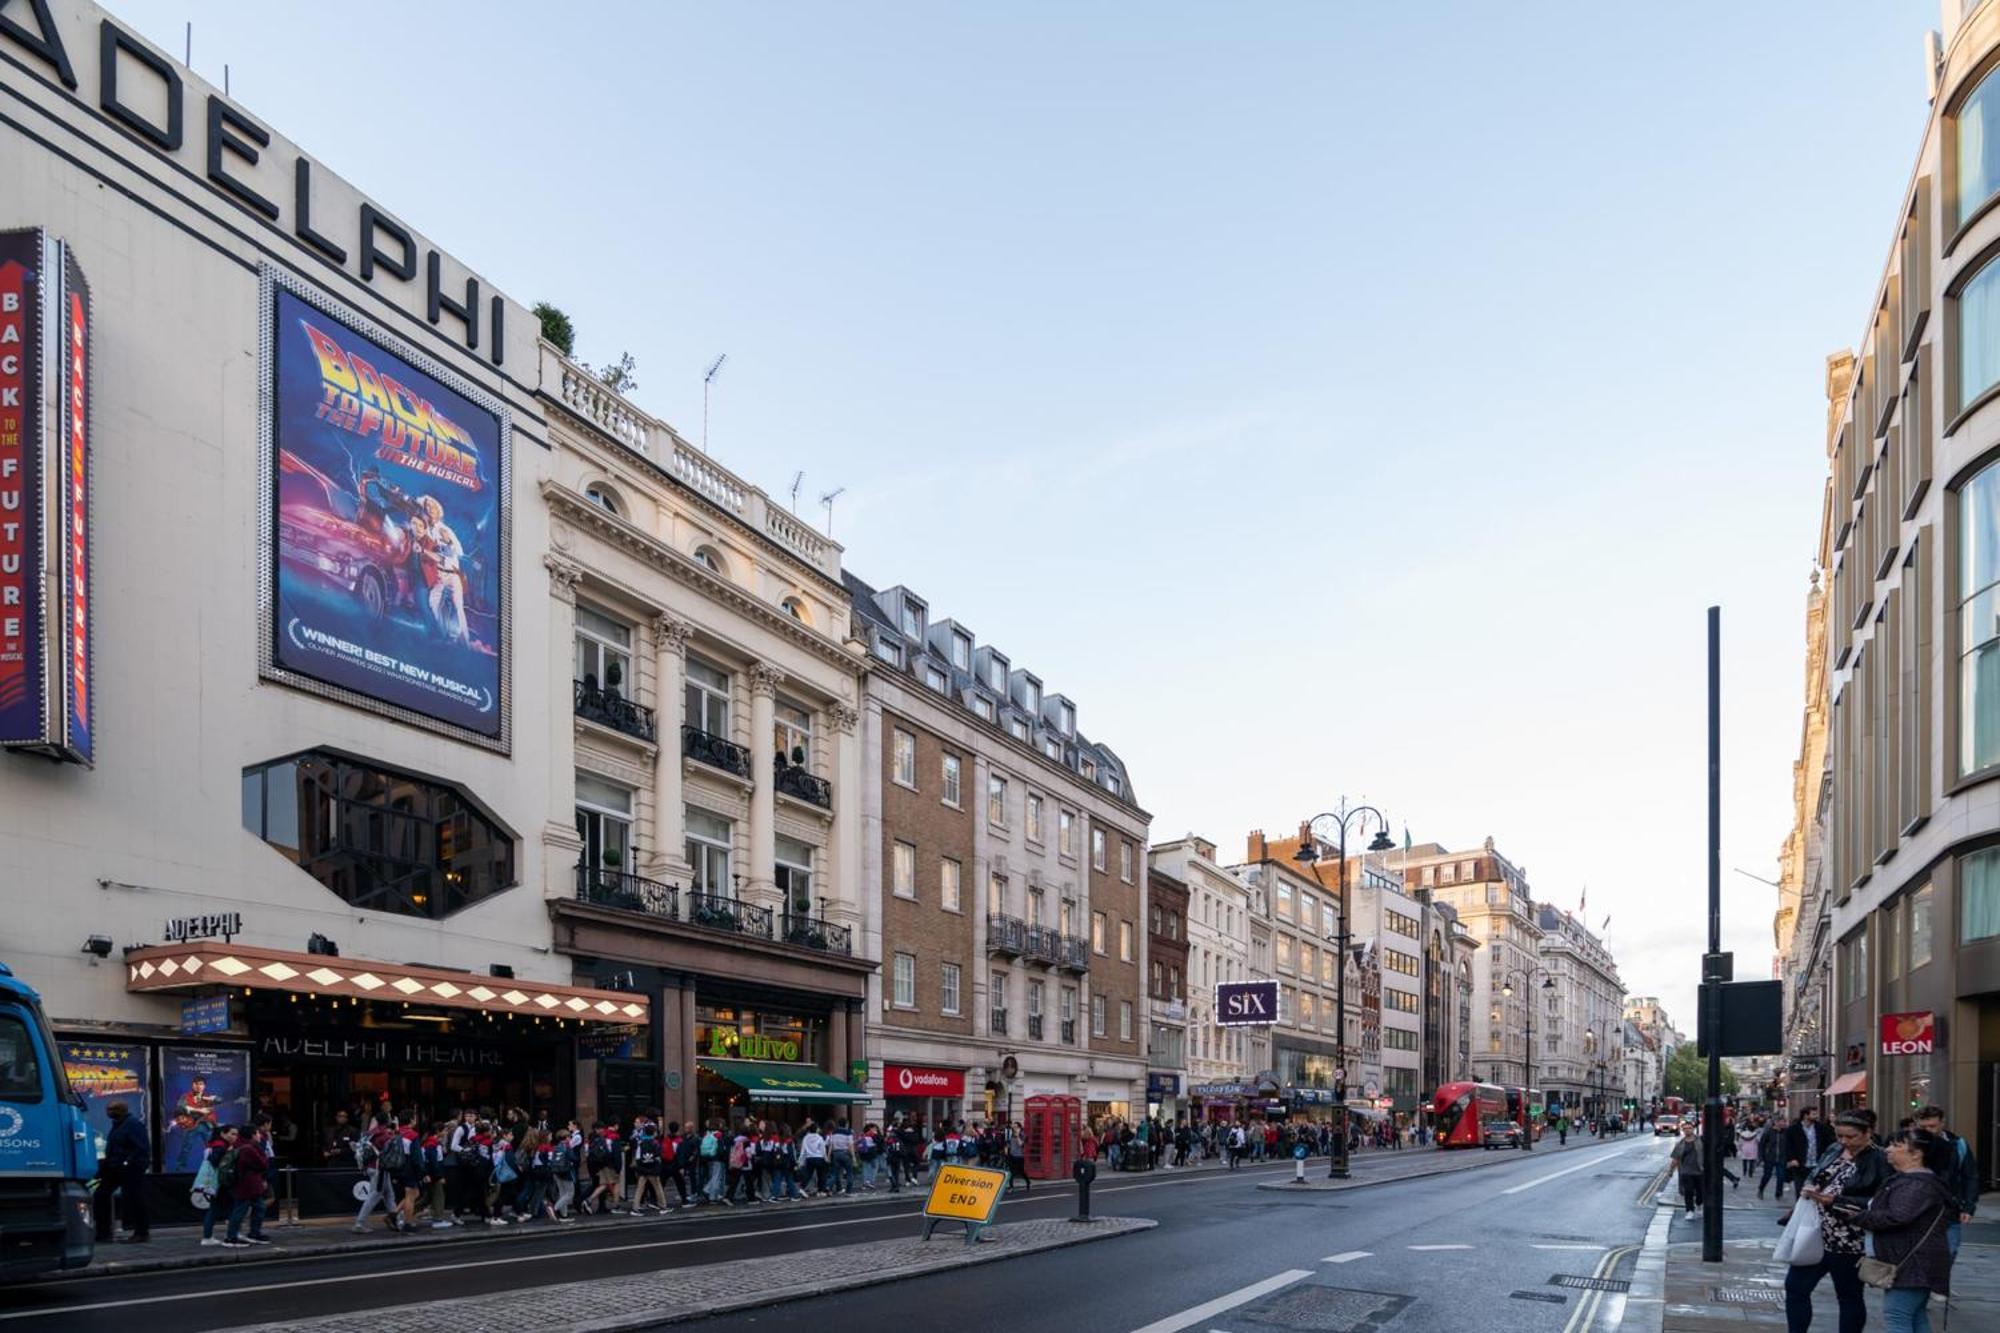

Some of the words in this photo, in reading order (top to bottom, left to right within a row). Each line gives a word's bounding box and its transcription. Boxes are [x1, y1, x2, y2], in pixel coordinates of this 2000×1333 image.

[0, 0, 505, 366] ADELPHI
[2, 292, 20, 407] BACK
[300, 319, 479, 452] BACK
[325, 382, 359, 415] TO
[4, 417, 16, 430] TO
[315, 403, 357, 432] THE
[1, 432, 18, 446] THE
[358, 402, 477, 475] FUTURE
[400, 454, 426, 471] THE
[426, 460, 478, 490] MUSICAL
[1, 459, 21, 637] FUTURE
[364, 648, 399, 670] BEST
[399, 661, 431, 682] NEW
[431, 672, 483, 701] MUSICAL
[165, 911, 240, 942] ADELPHI
[1228, 992, 1266, 1016] SIX
[263, 1037, 386, 1060] ADELPHI
[403, 1044, 505, 1065] THEATRE
[1882, 1039, 1932, 1055] LEON
[914, 1073, 949, 1086] vodafone
[943, 1174, 994, 1189] Diversion
[949, 1193, 977, 1206] END
